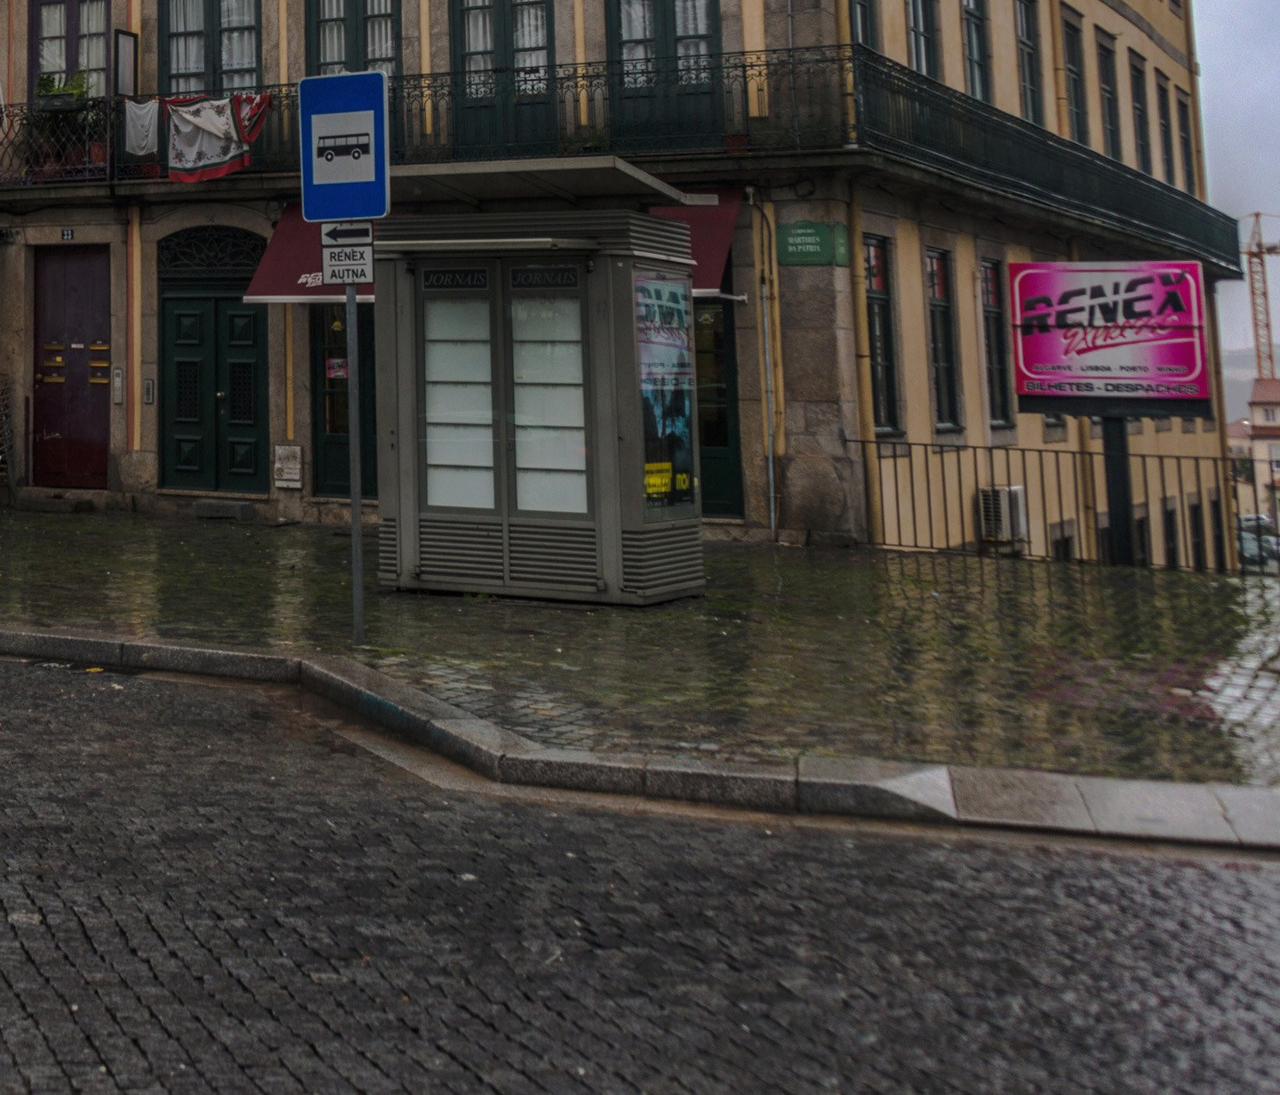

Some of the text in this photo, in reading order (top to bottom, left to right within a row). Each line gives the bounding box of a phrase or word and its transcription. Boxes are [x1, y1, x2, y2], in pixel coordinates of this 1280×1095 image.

[329, 250, 366, 262] RENEX
[330, 268, 367, 280] AUTNA
[424, 273, 486, 286] JORNAIS
[513, 272, 578, 285] JORNAIS
[1022, 270, 1189, 336] RENEX
[1119, 365, 1150, 373] PORTO
[1026, 381, 1199, 395] BILHETES DESPACHOS
